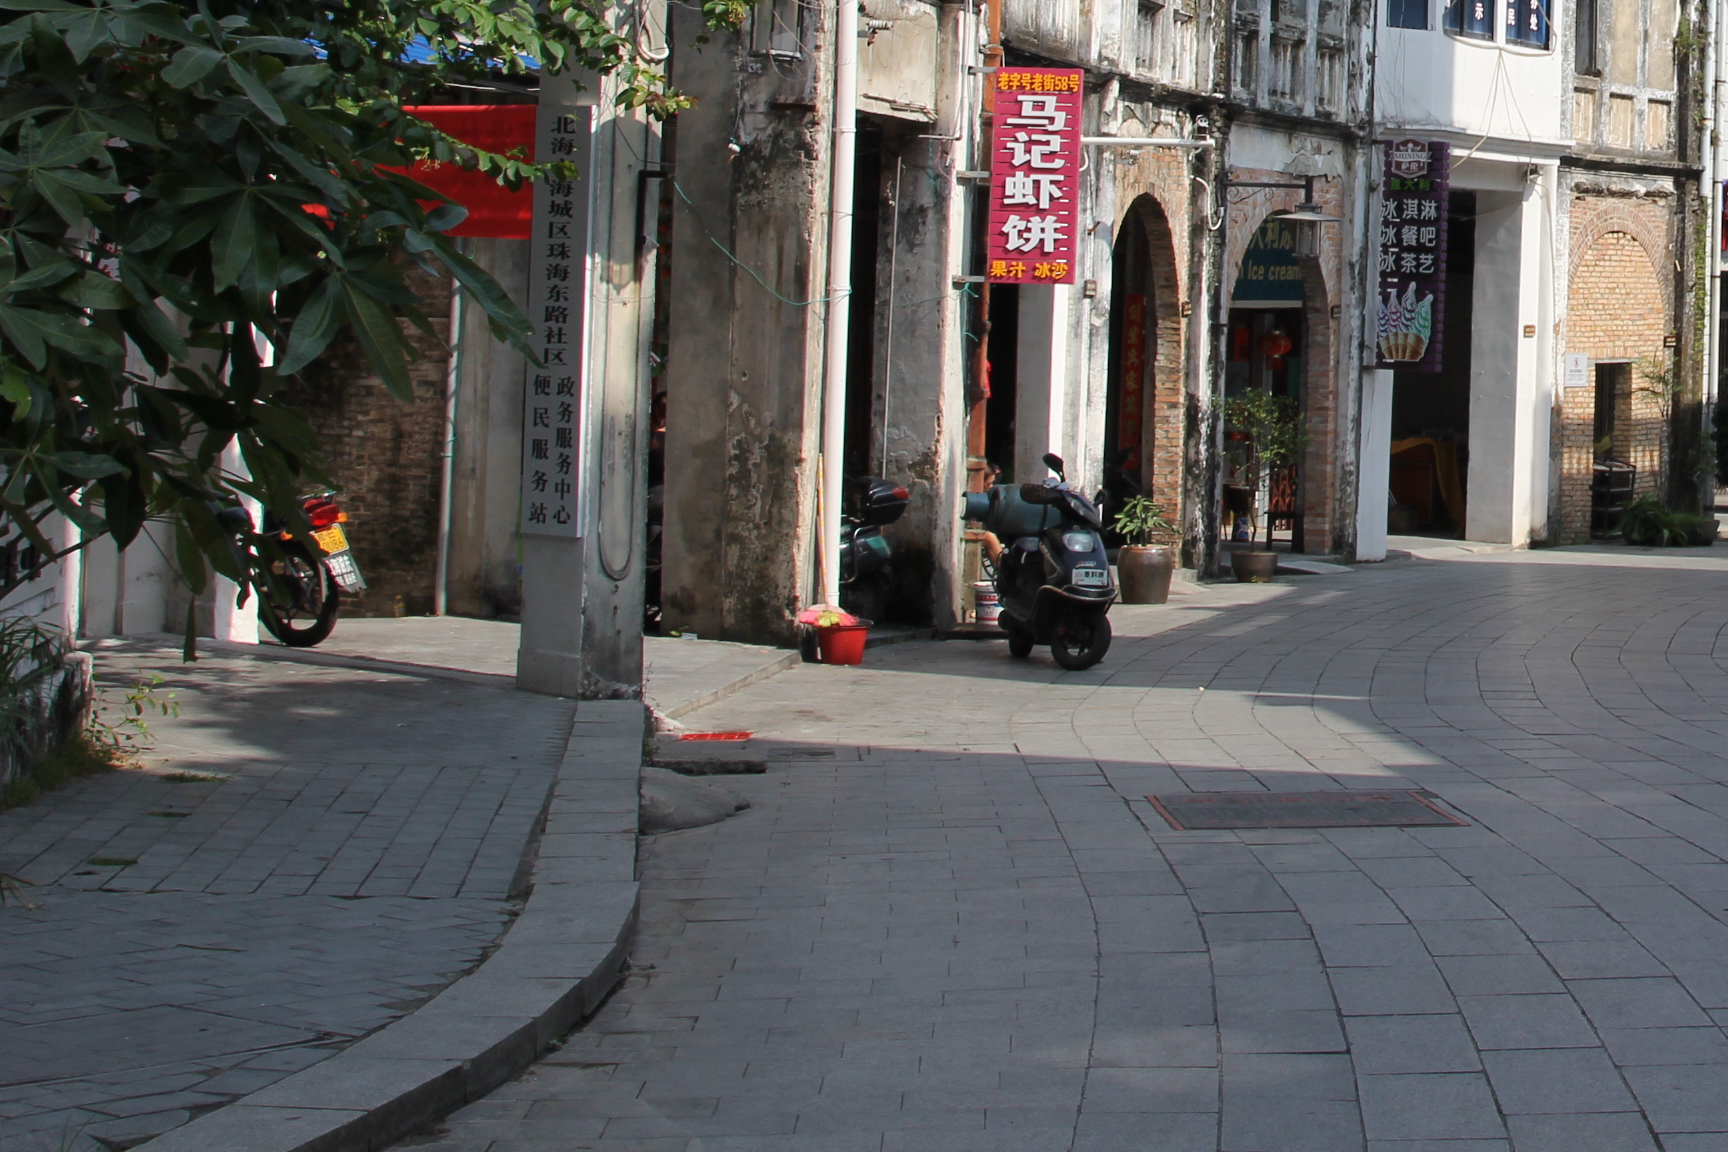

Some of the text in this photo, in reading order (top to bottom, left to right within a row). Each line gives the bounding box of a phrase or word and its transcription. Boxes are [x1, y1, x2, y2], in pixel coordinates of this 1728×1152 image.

[998, 72, 1080, 92] 老字号老街58号
[1394, 152, 1426, 160] SHINING
[1002, 95, 1067, 252] 马记虾饼
[1390, 178, 1430, 191] 意大利
[1381, 198, 1437, 221] 冰淇淋
[543, 115, 576, 366] 北海海城区珠海东路社区
[1380, 225, 1436, 247] 冰餐吧
[991, 260, 1069, 280] 果汁 冰沙
[1379, 251, 1435, 274] 冰茶艺
[528, 374, 551, 525] 便民服务站
[552, 376, 575, 525] 政务服务中心
